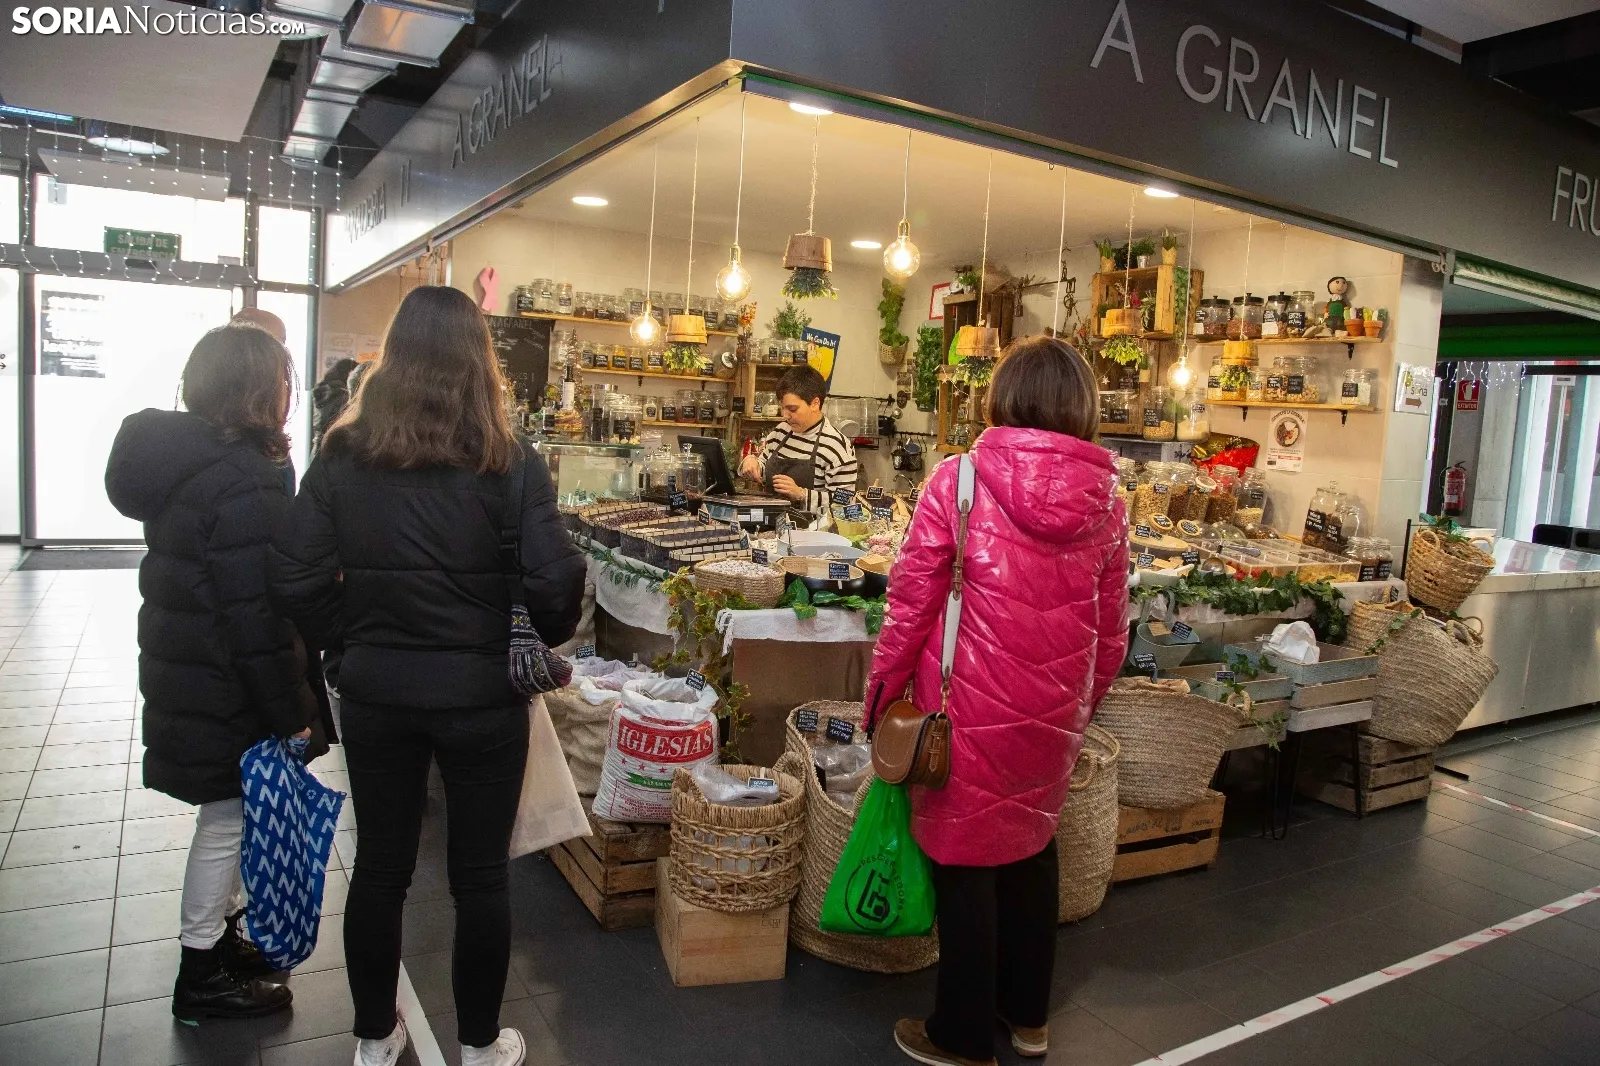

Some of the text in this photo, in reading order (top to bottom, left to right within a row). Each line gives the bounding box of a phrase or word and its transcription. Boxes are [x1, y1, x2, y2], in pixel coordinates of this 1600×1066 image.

[451, 34, 552, 169] A GRANEL
[1090, 0, 1398, 168] A GRANEL
[619, 726, 712, 757] IGLESIAS
